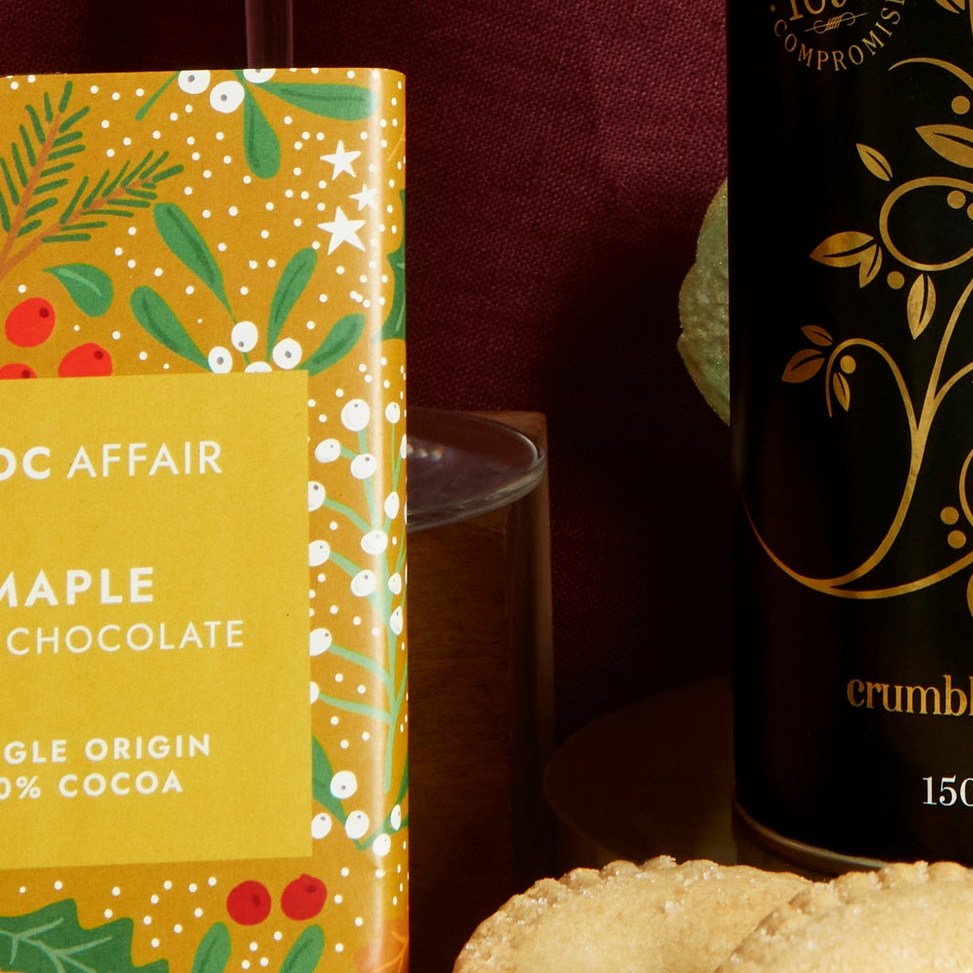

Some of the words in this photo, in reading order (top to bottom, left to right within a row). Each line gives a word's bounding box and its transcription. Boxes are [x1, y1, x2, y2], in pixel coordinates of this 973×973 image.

[66, 440, 223, 479] AFFAIR
[6, 620, 244, 656] CHOCOLATE
[84, 734, 211, 762] ORIGIN
[58, 770, 183, 798] COCOA
